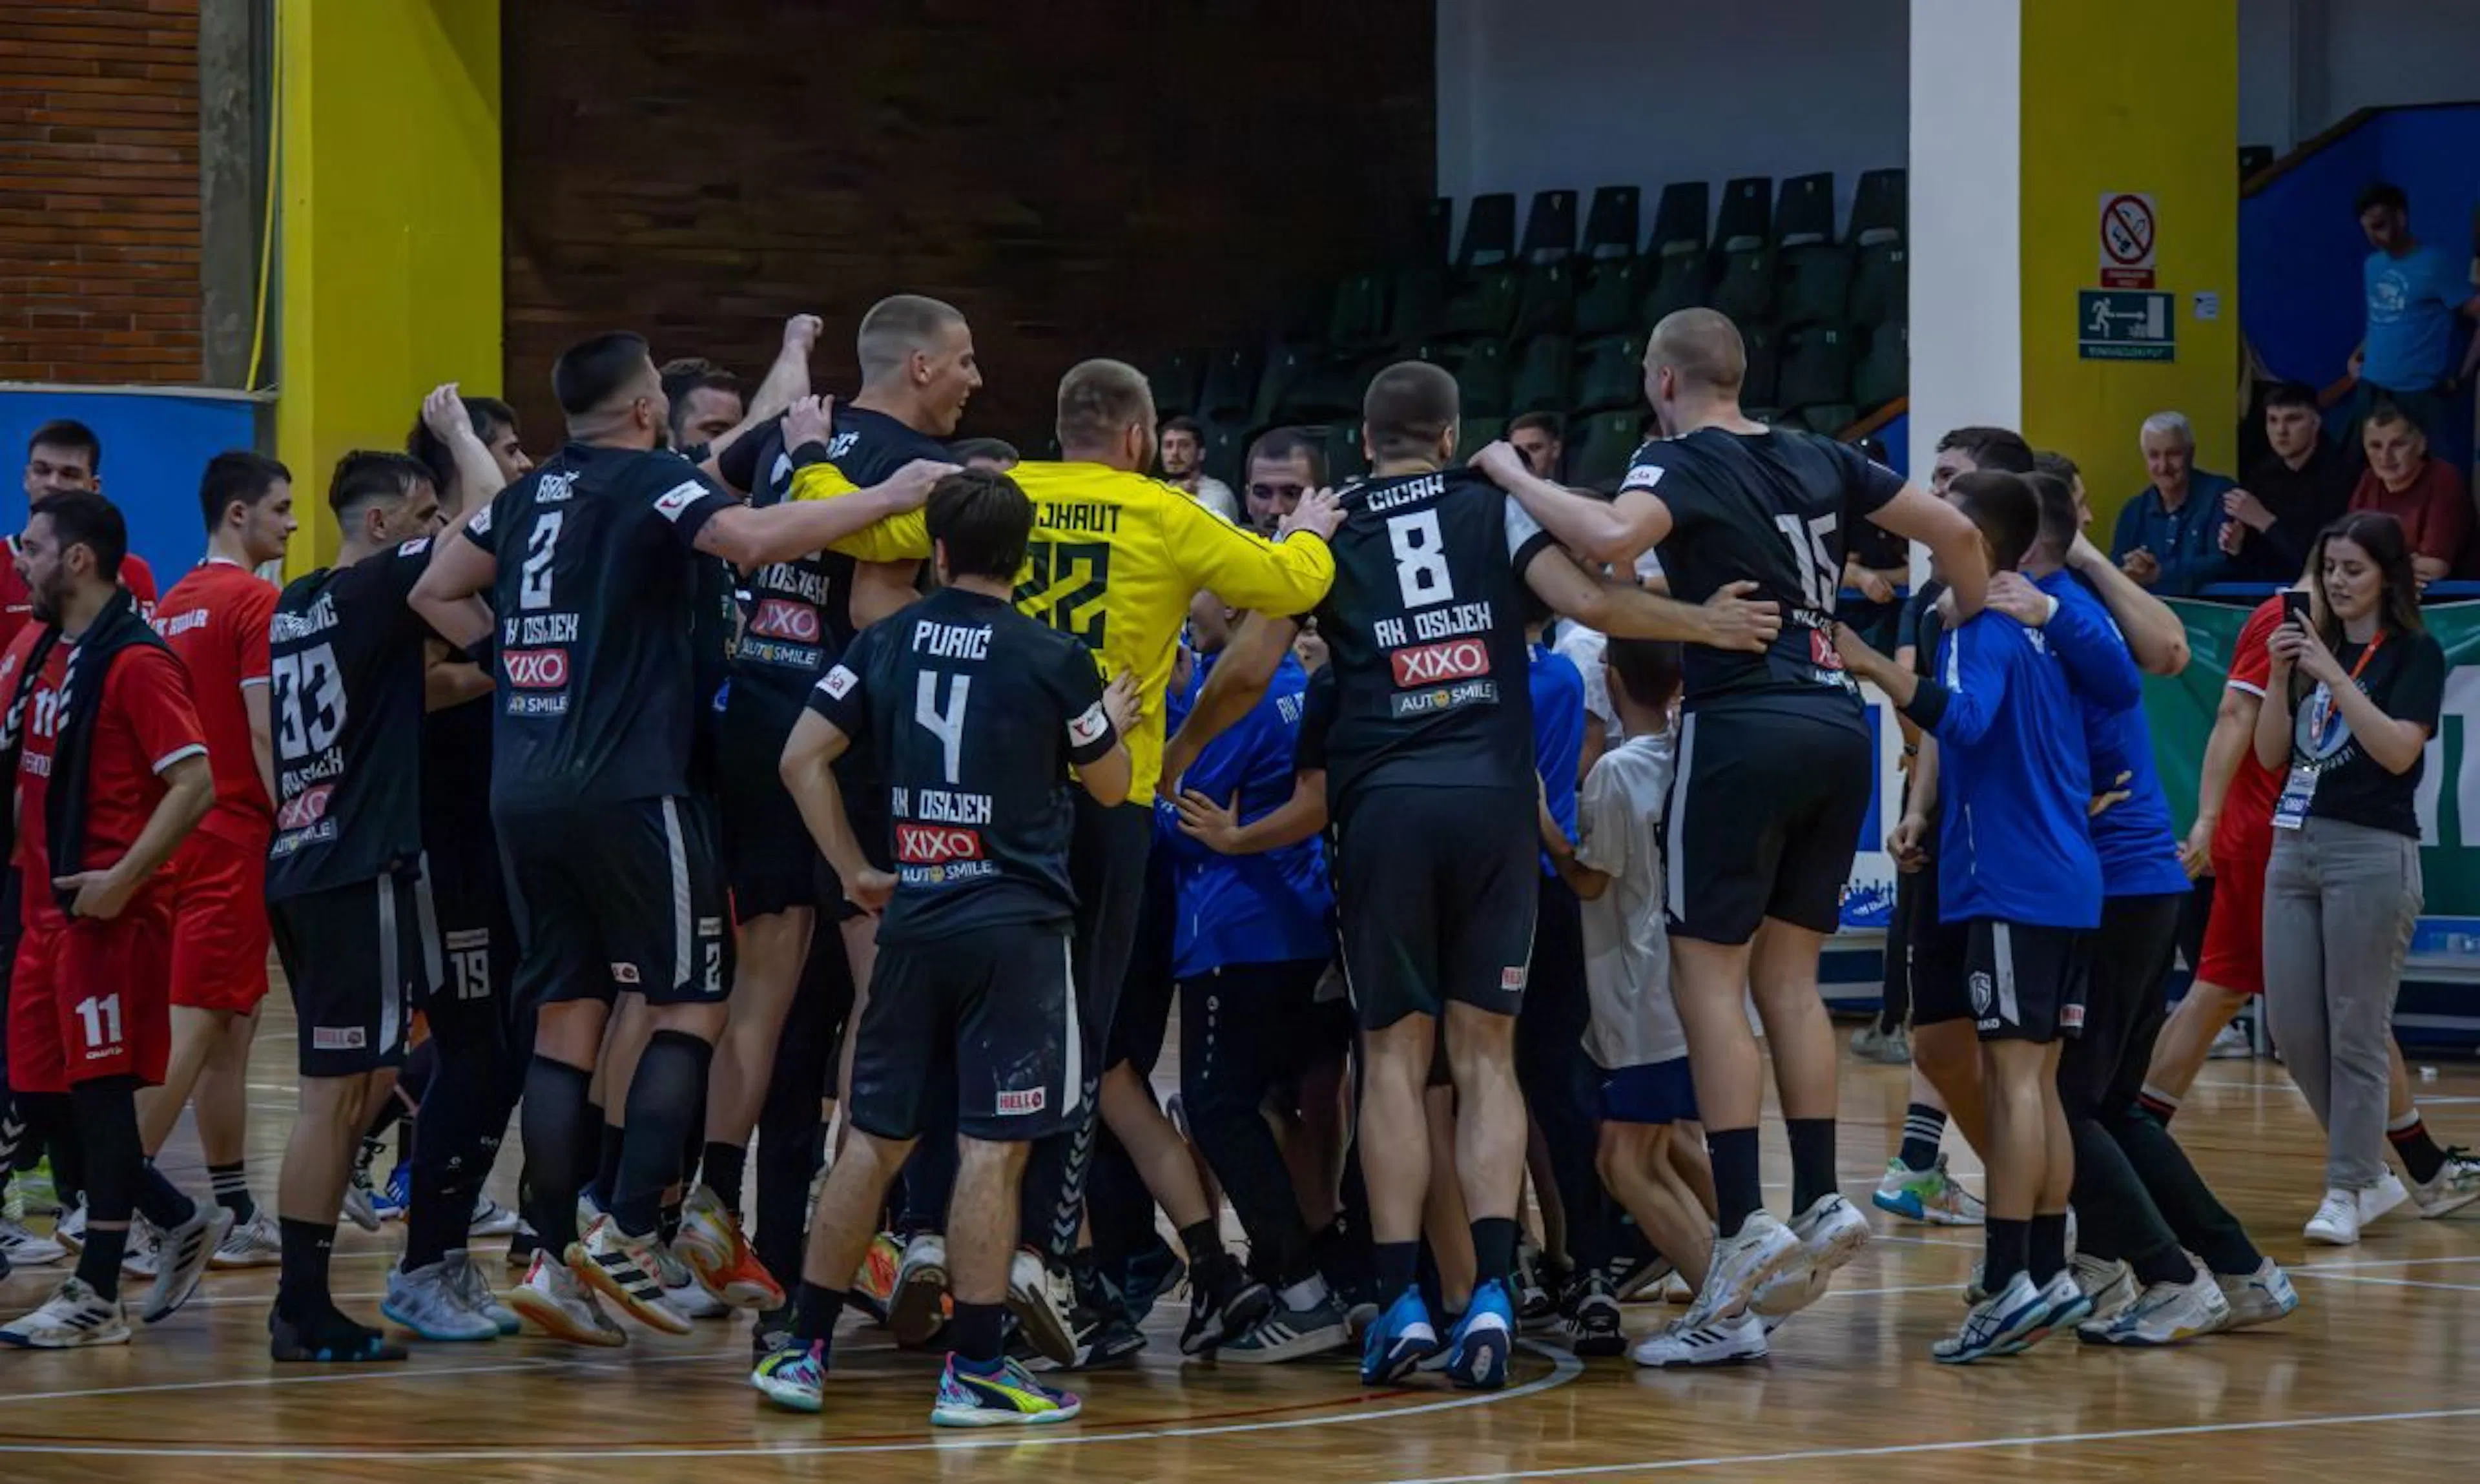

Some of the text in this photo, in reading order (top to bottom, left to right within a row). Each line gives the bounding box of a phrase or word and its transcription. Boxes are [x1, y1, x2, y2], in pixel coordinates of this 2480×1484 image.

[1031, 502, 1123, 534] JHAUT
[520, 510, 564, 610] 2
[1387, 508, 1454, 609] 8
[1775, 511, 1842, 614] 15
[1414, 602, 1494, 641] OSIJEK
[1400, 644, 1482, 681] XIXO
[270, 643, 349, 760] 33
[527, 695, 569, 713] SMILE
[1452, 683, 1492, 703] SMILE
[915, 668, 971, 785] 4
[918, 788, 993, 825] OSIJEK
[902, 828, 976, 860] XIXO
[946, 859, 994, 881] SMILE
[450, 949, 491, 1000] 19
[705, 942, 721, 993] 2
[75, 992, 123, 1047] 11
